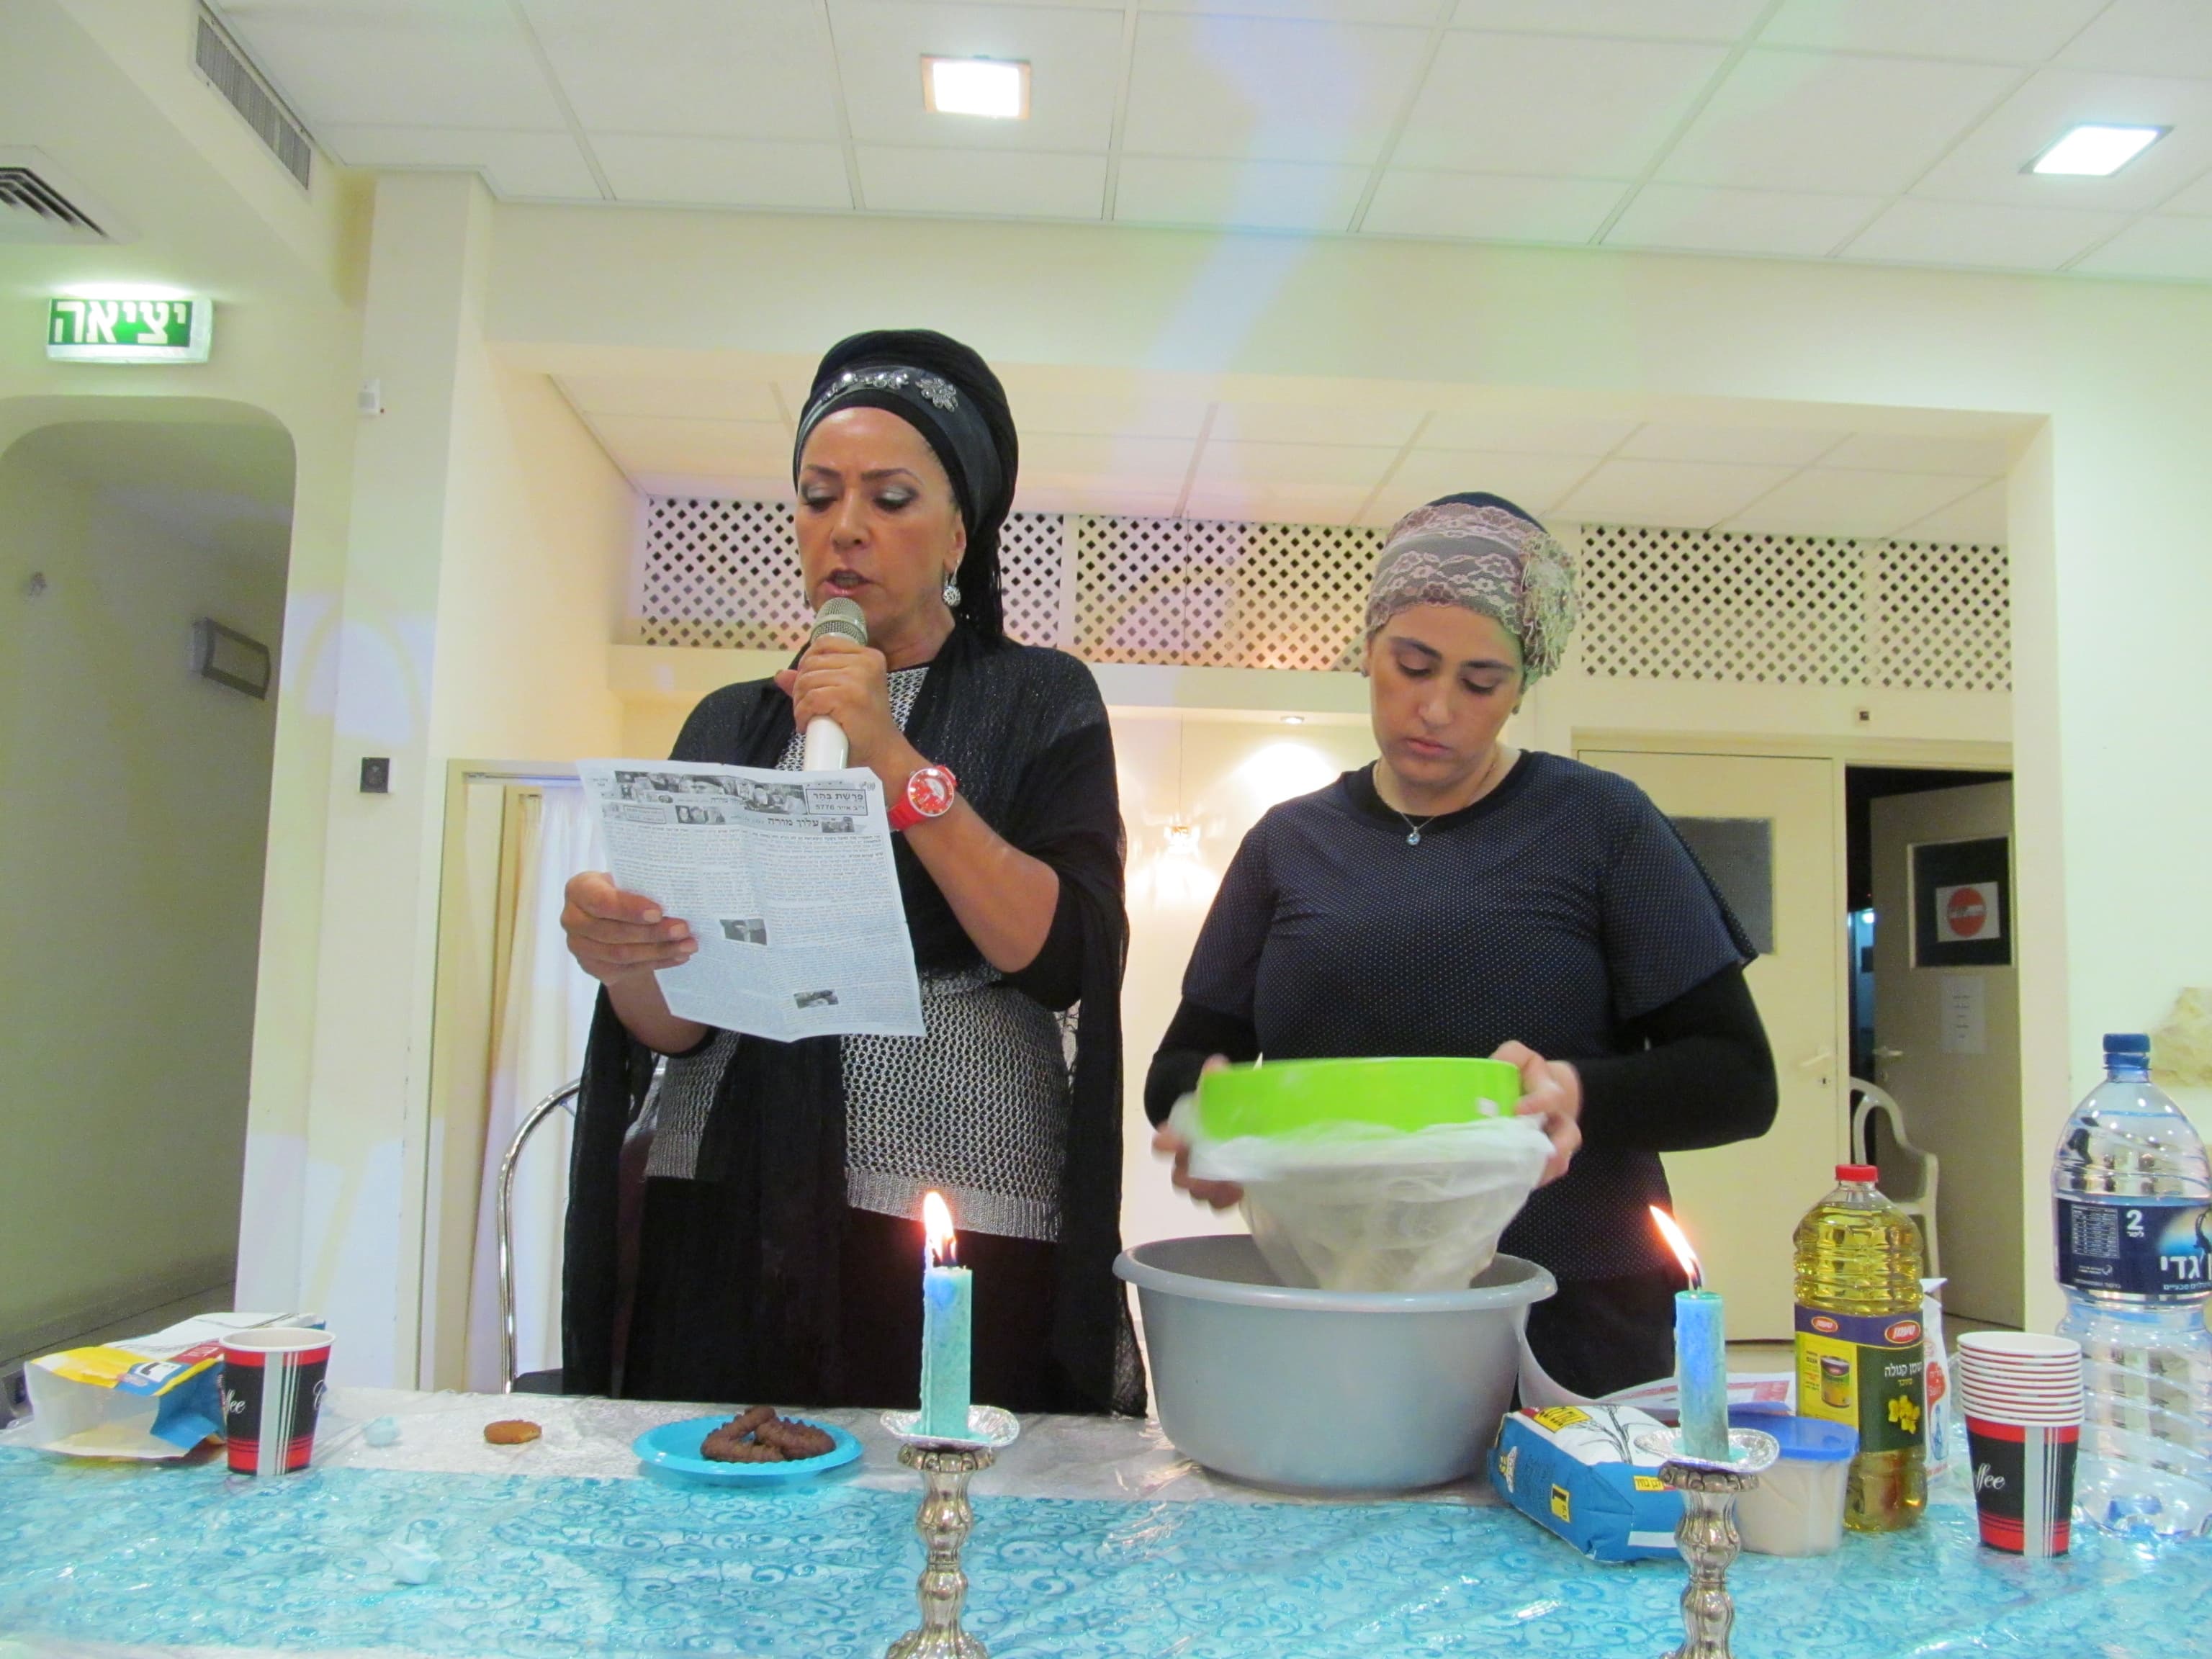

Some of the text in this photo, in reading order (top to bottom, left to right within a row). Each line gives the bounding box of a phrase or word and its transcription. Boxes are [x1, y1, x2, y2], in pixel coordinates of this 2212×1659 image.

[54, 300, 187, 343] יציאה
[2126, 1210, 2144, 1231] 2
[2161, 1255, 2201, 1280] גדי
[1977, 1462, 2005, 1492] ffee
